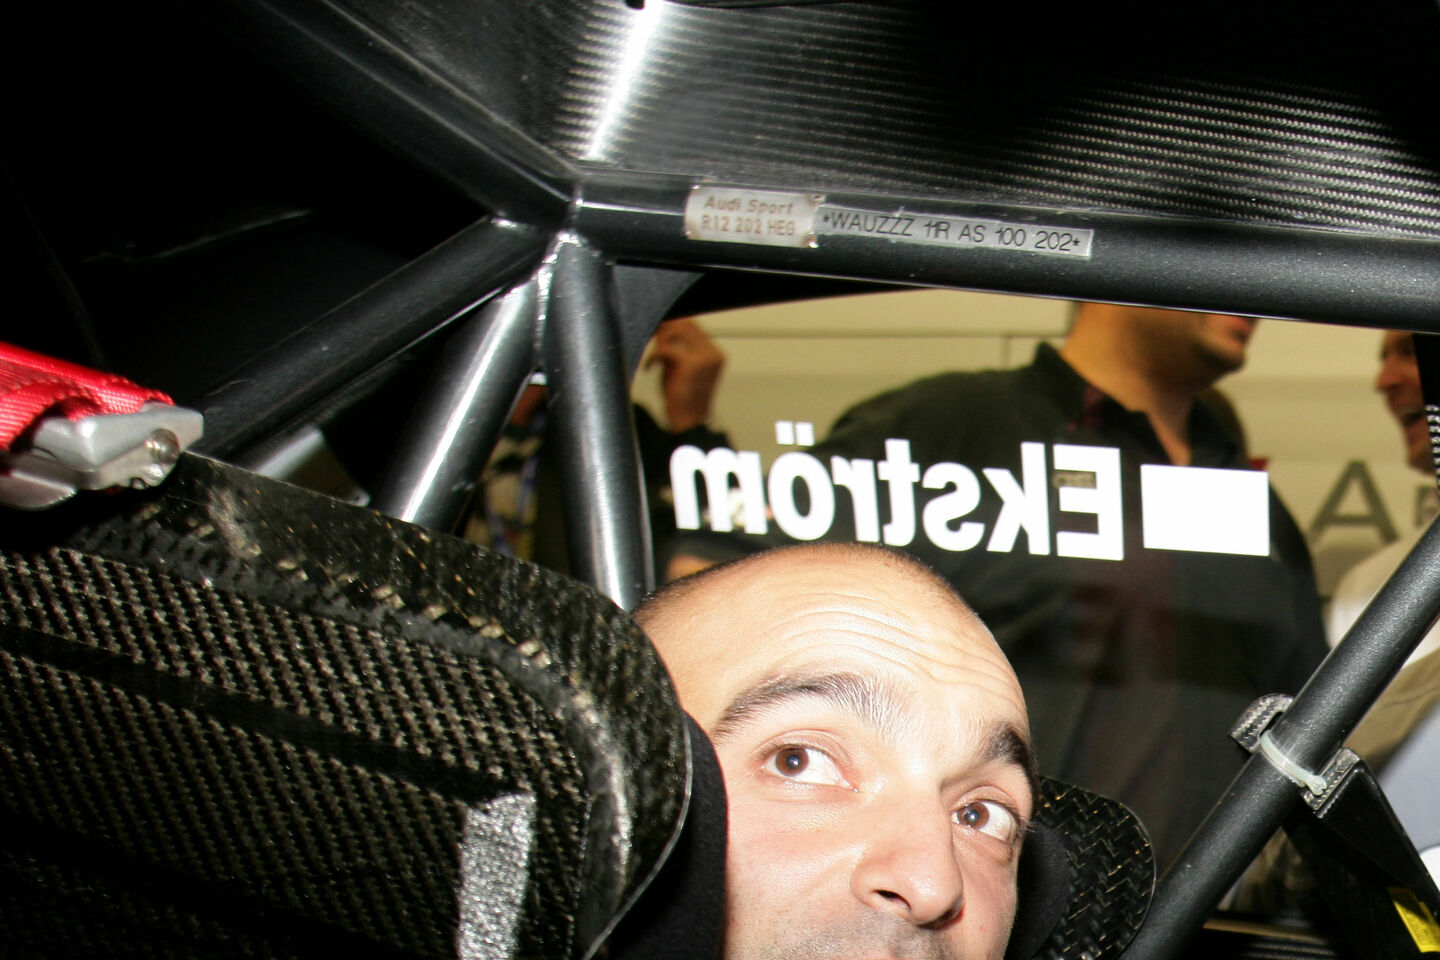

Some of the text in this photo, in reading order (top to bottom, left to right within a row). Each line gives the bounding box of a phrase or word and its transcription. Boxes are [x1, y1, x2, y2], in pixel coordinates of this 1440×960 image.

[704, 196, 794, 216] Audi Sport
[959, 223, 986, 243] AS
[995, 227, 1026, 247] 100
